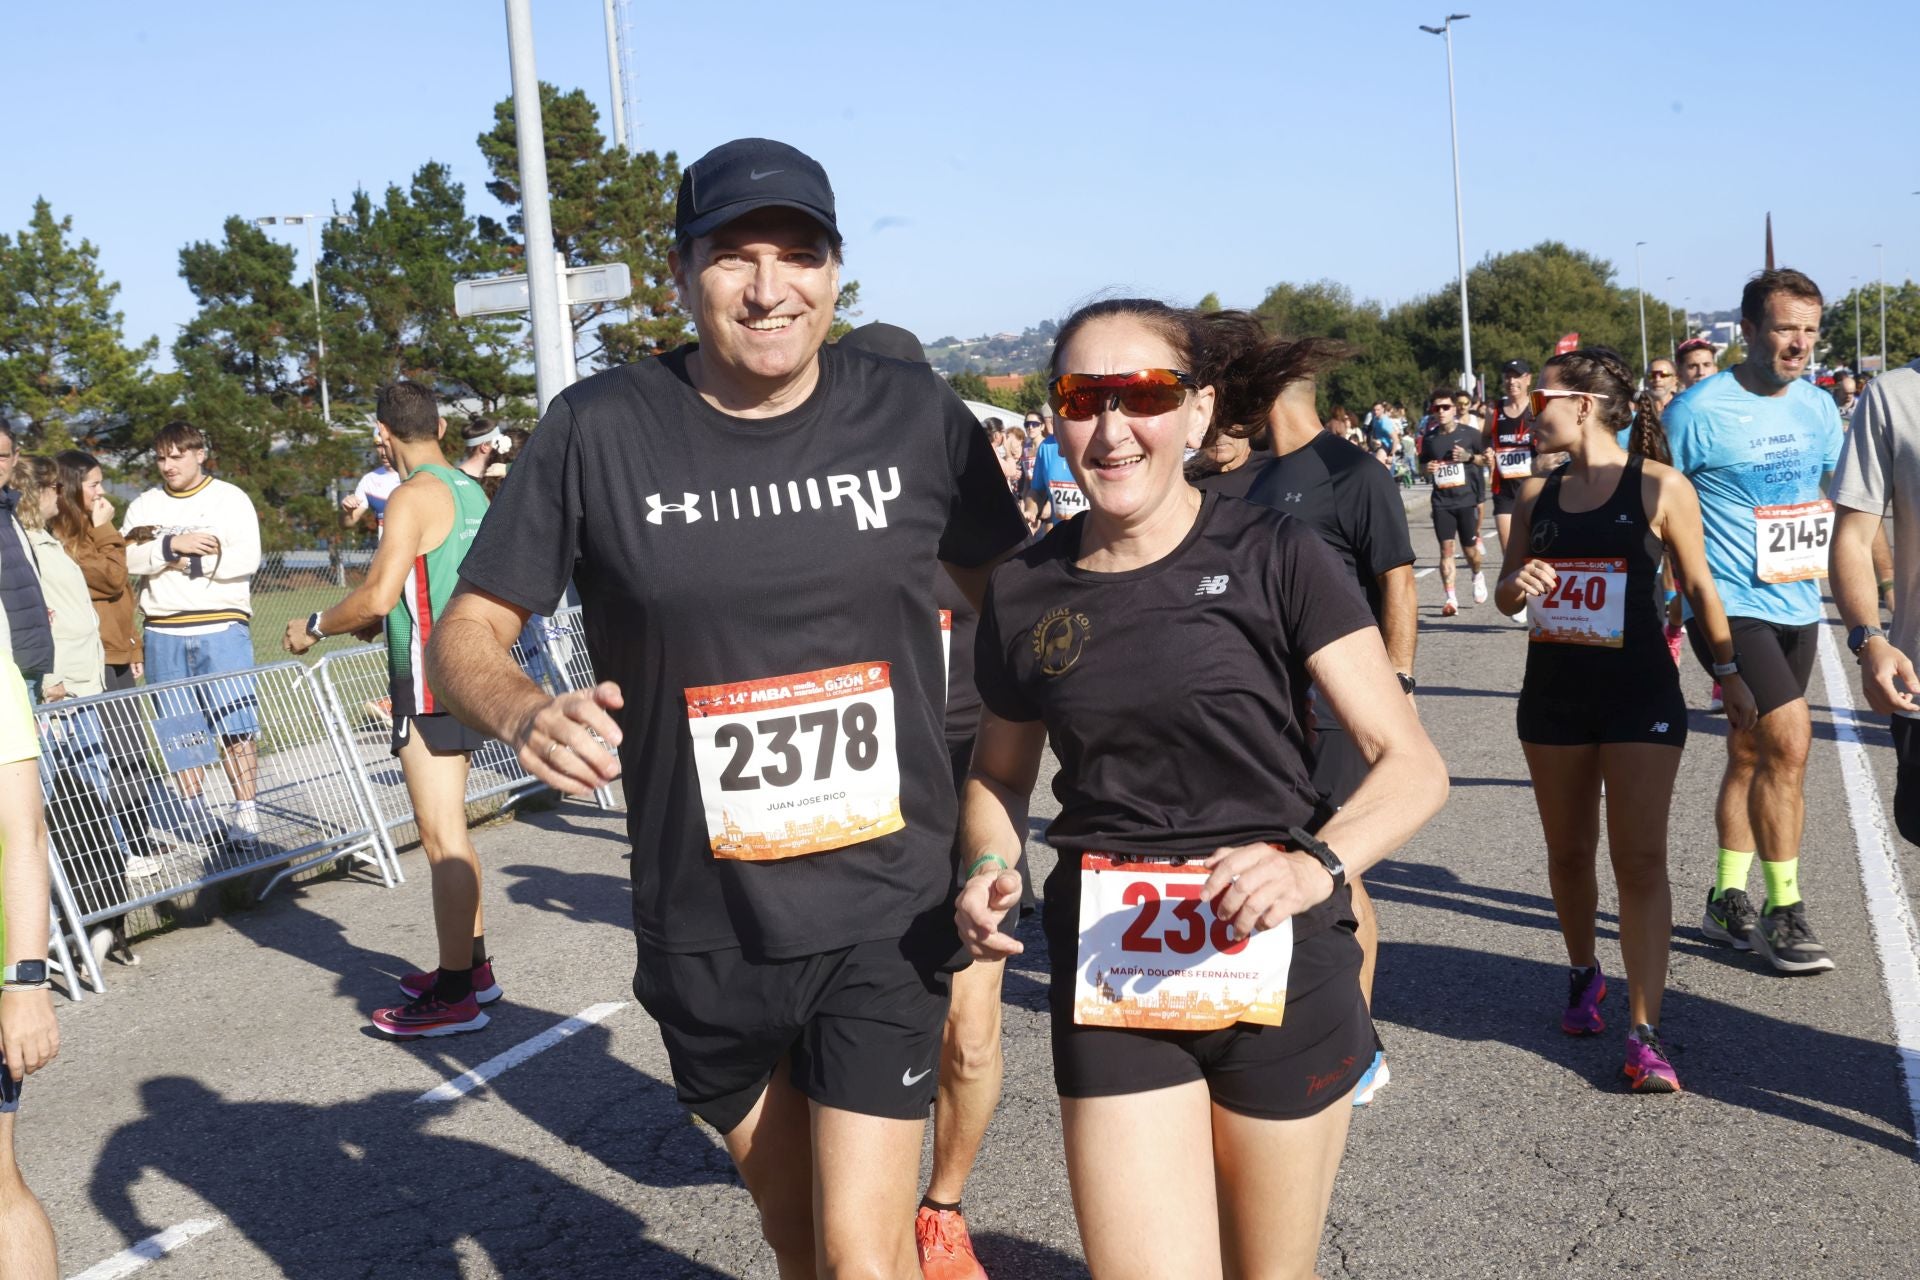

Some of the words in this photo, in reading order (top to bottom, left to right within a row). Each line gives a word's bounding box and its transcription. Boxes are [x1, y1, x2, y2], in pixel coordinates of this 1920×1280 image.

[1768, 434, 1796, 445] MBA
[1500, 453, 1526, 466] 2001
[1764, 447, 1799, 460] media
[1438, 465, 1459, 477] 2160
[1753, 458, 1800, 472] maratón
[1765, 469, 1801, 484] GIJÓN
[1768, 517, 1828, 553] 2145
[1542, 575, 1607, 611] 240
[793, 681, 816, 690] media
[825, 674, 864, 692] GIJÓN
[751, 686, 792, 703] MBA
[794, 687, 824, 697] maratón
[714, 702, 879, 792] 2378
[767, 801, 795, 811] JUAN
[797, 796, 821, 807] JOSE
[823, 791, 846, 802] RICO
[1110, 965, 1145, 977] MARÍA
[1147, 969, 1193, 978] DOLORES
[1196, 968, 1260, 980] FERNÁNDEZ
